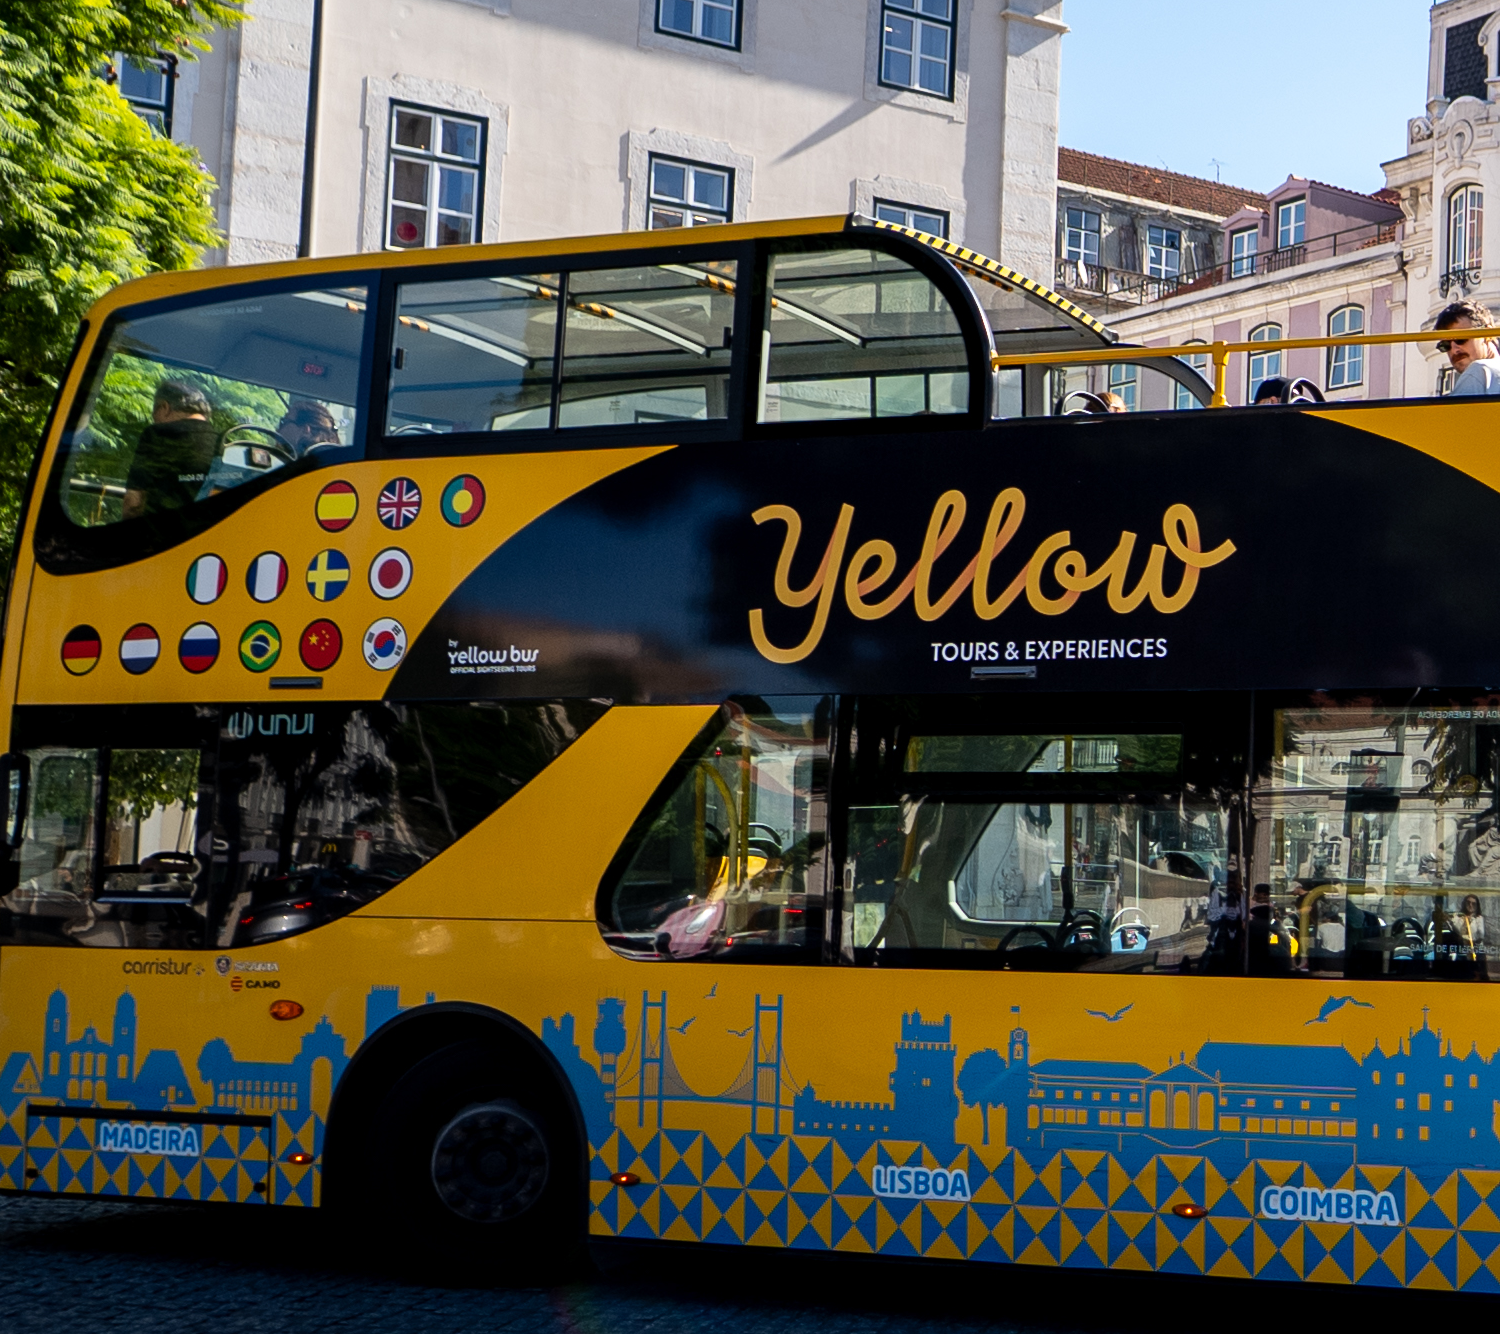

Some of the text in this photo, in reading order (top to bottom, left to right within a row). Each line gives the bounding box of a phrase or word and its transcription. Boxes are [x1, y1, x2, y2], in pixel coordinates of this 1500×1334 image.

[748, 487, 1237, 664] Yellow
[510, 645, 539, 662] bus
[931, 638, 1168, 662] TOURS & EXPERIENCES
[122, 958, 191, 975] carristur
[102, 1124, 198, 1155] MADEIRA
[875, 1167, 970, 1200] LISBOA
[1262, 1187, 1397, 1223] COIMBRA
